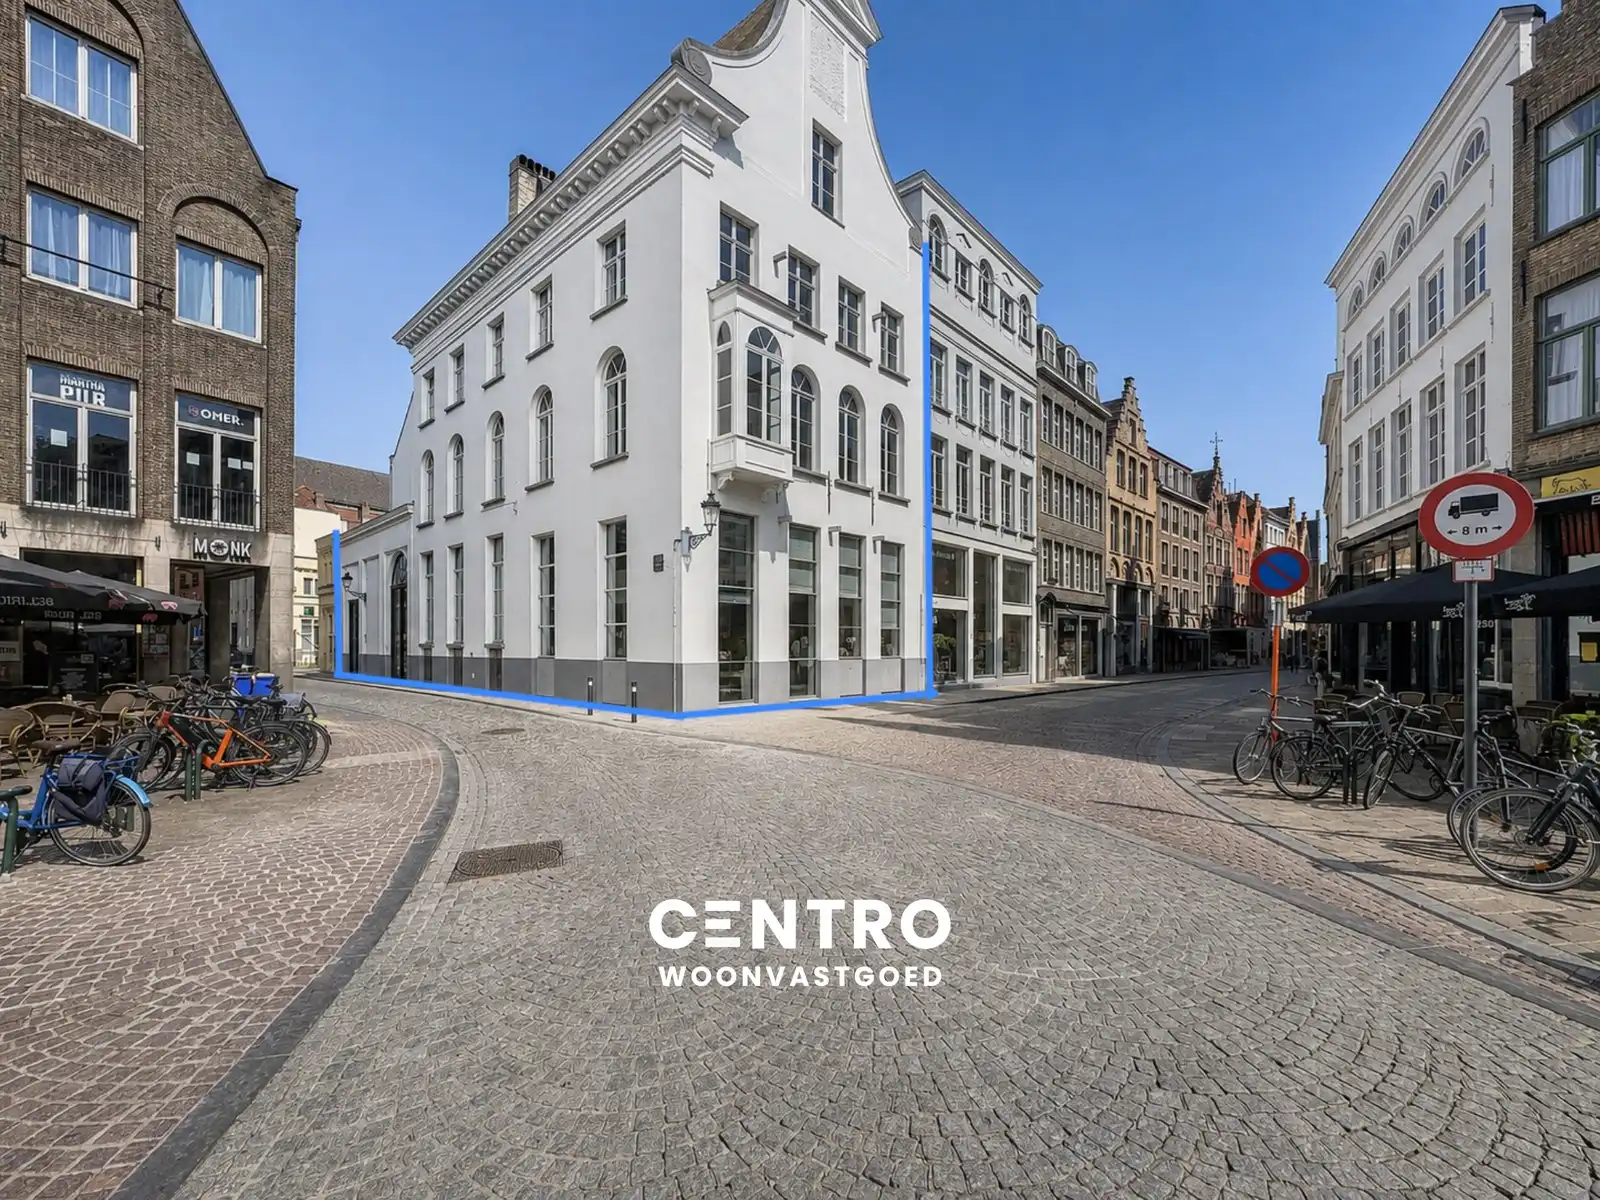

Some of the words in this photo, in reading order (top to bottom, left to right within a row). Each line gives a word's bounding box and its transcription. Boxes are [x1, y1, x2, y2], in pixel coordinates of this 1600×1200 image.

[1462, 525, 1470, 536] 8
[1475, 526, 1488, 534] m
[194, 537, 251, 557] MONK
